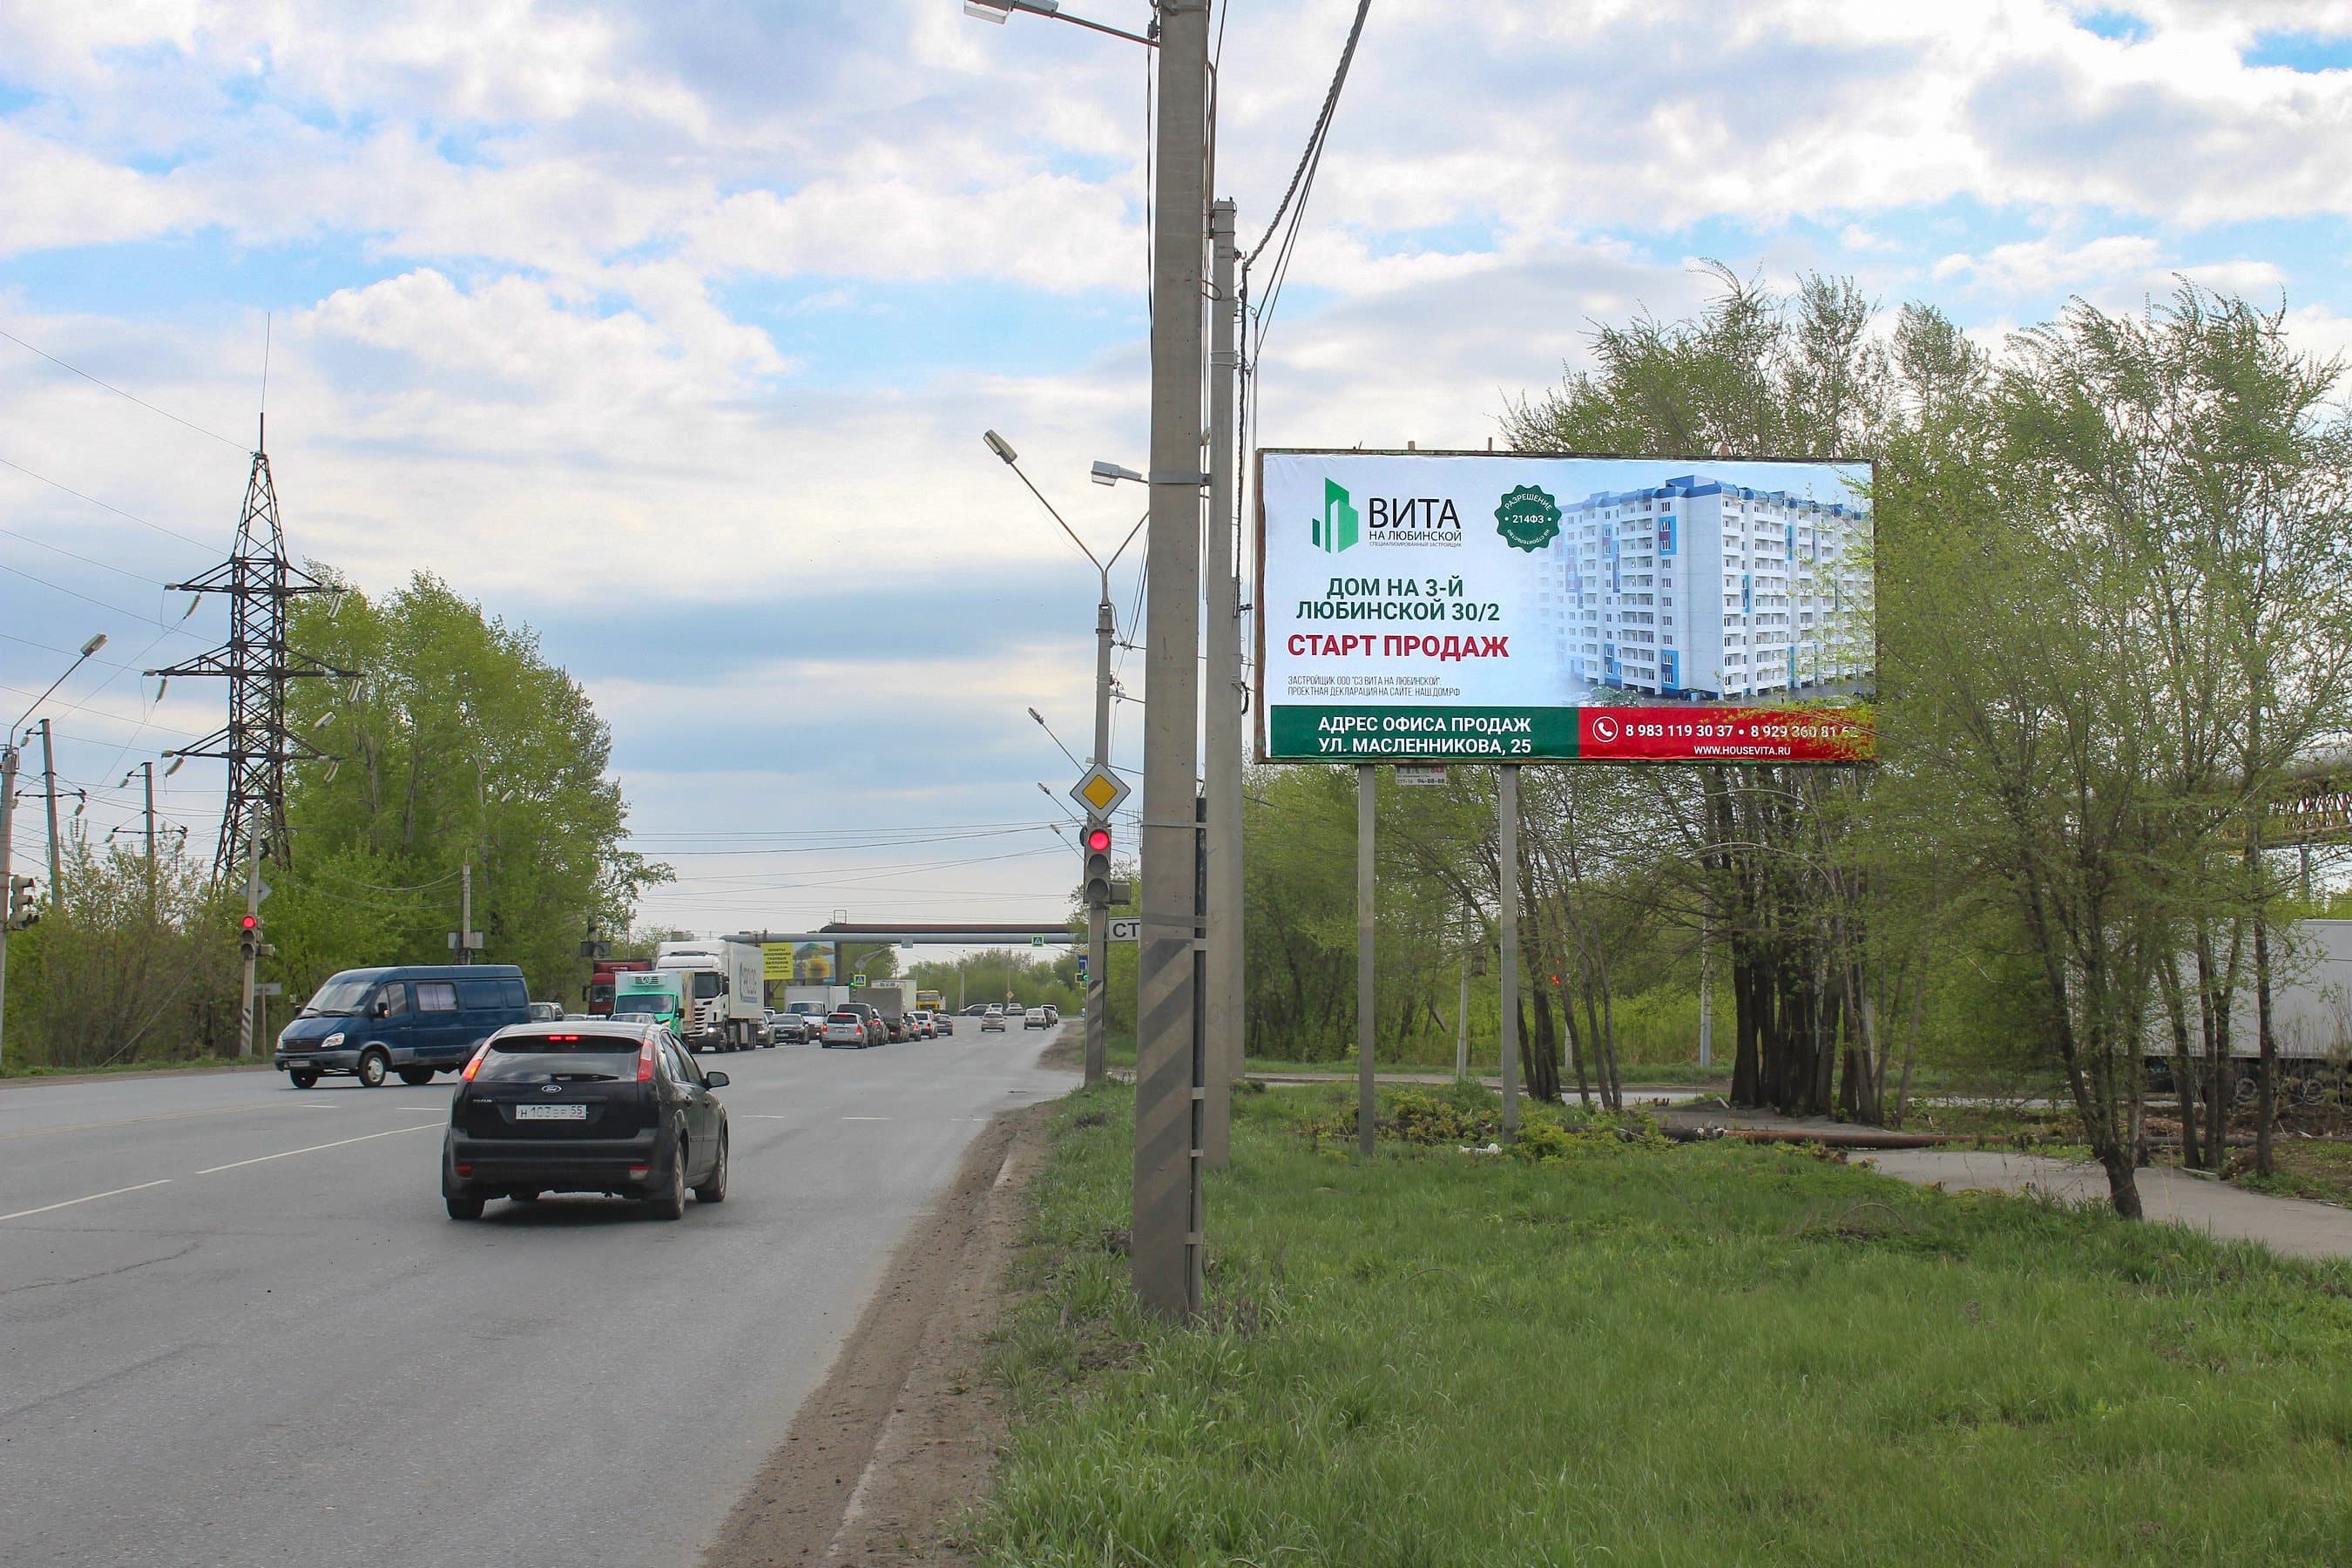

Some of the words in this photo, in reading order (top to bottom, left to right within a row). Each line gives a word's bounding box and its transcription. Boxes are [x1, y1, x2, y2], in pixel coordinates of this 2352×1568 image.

[1504, 493, 1552, 511] РАЗРЕШЕНИЕ
[1369, 497, 1461, 529] ВИТА
[1512, 514, 1544, 524] 214ФЗ
[1369, 531, 1385, 540] НА
[1388, 530, 1462, 541] ЛЮБИНСКОЙ
[1327, 578, 1380, 599] ДОМ
[1387, 578, 1419, 597] НА
[1425, 575, 1463, 597] 3-Й
[1296, 598, 1445, 620] ЛЮБИНСКОЙ
[1451, 603, 1500, 622] 30/2
[1288, 634, 1376, 656] СТАРТ
[1384, 635, 1510, 662] ПРОДАЖ
[1288, 675, 1335, 686] ЗАСТРОЙЩИК
[1336, 676, 1351, 686] ООО
[1364, 676, 1383, 686] ВИТА
[1384, 676, 1394, 686] НА
[1288, 686, 1329, 696] ПРОЕКТНАЯ
[1330, 686, 1378, 697] ДЕКЛАРАЦИЯ
[1378, 686, 1389, 696] НА
[1318, 717, 1378, 733] АДРЕС
[1382, 717, 1447, 732] ОФИСА
[1451, 718, 1531, 735] ПРОДАЖ
[1625, 725, 1634, 737] 8
[1638, 725, 1664, 737] 983
[1667, 725, 1693, 737] 119
[1696, 725, 1713, 737] 30
[1717, 725, 1734, 737] 37
[1751, 725, 1759, 738] 8
[1762, 725, 1788, 738] 929
[1319, 738, 1348, 753] УЛ.
[1353, 738, 1506, 756] МАСЛЕННИКОВА,
[1511, 739, 1531, 754] 25
[1693, 745, 1791, 755] WWW.HOUSEVITA.RU
[1112, 923, 1140, 938] СТ
